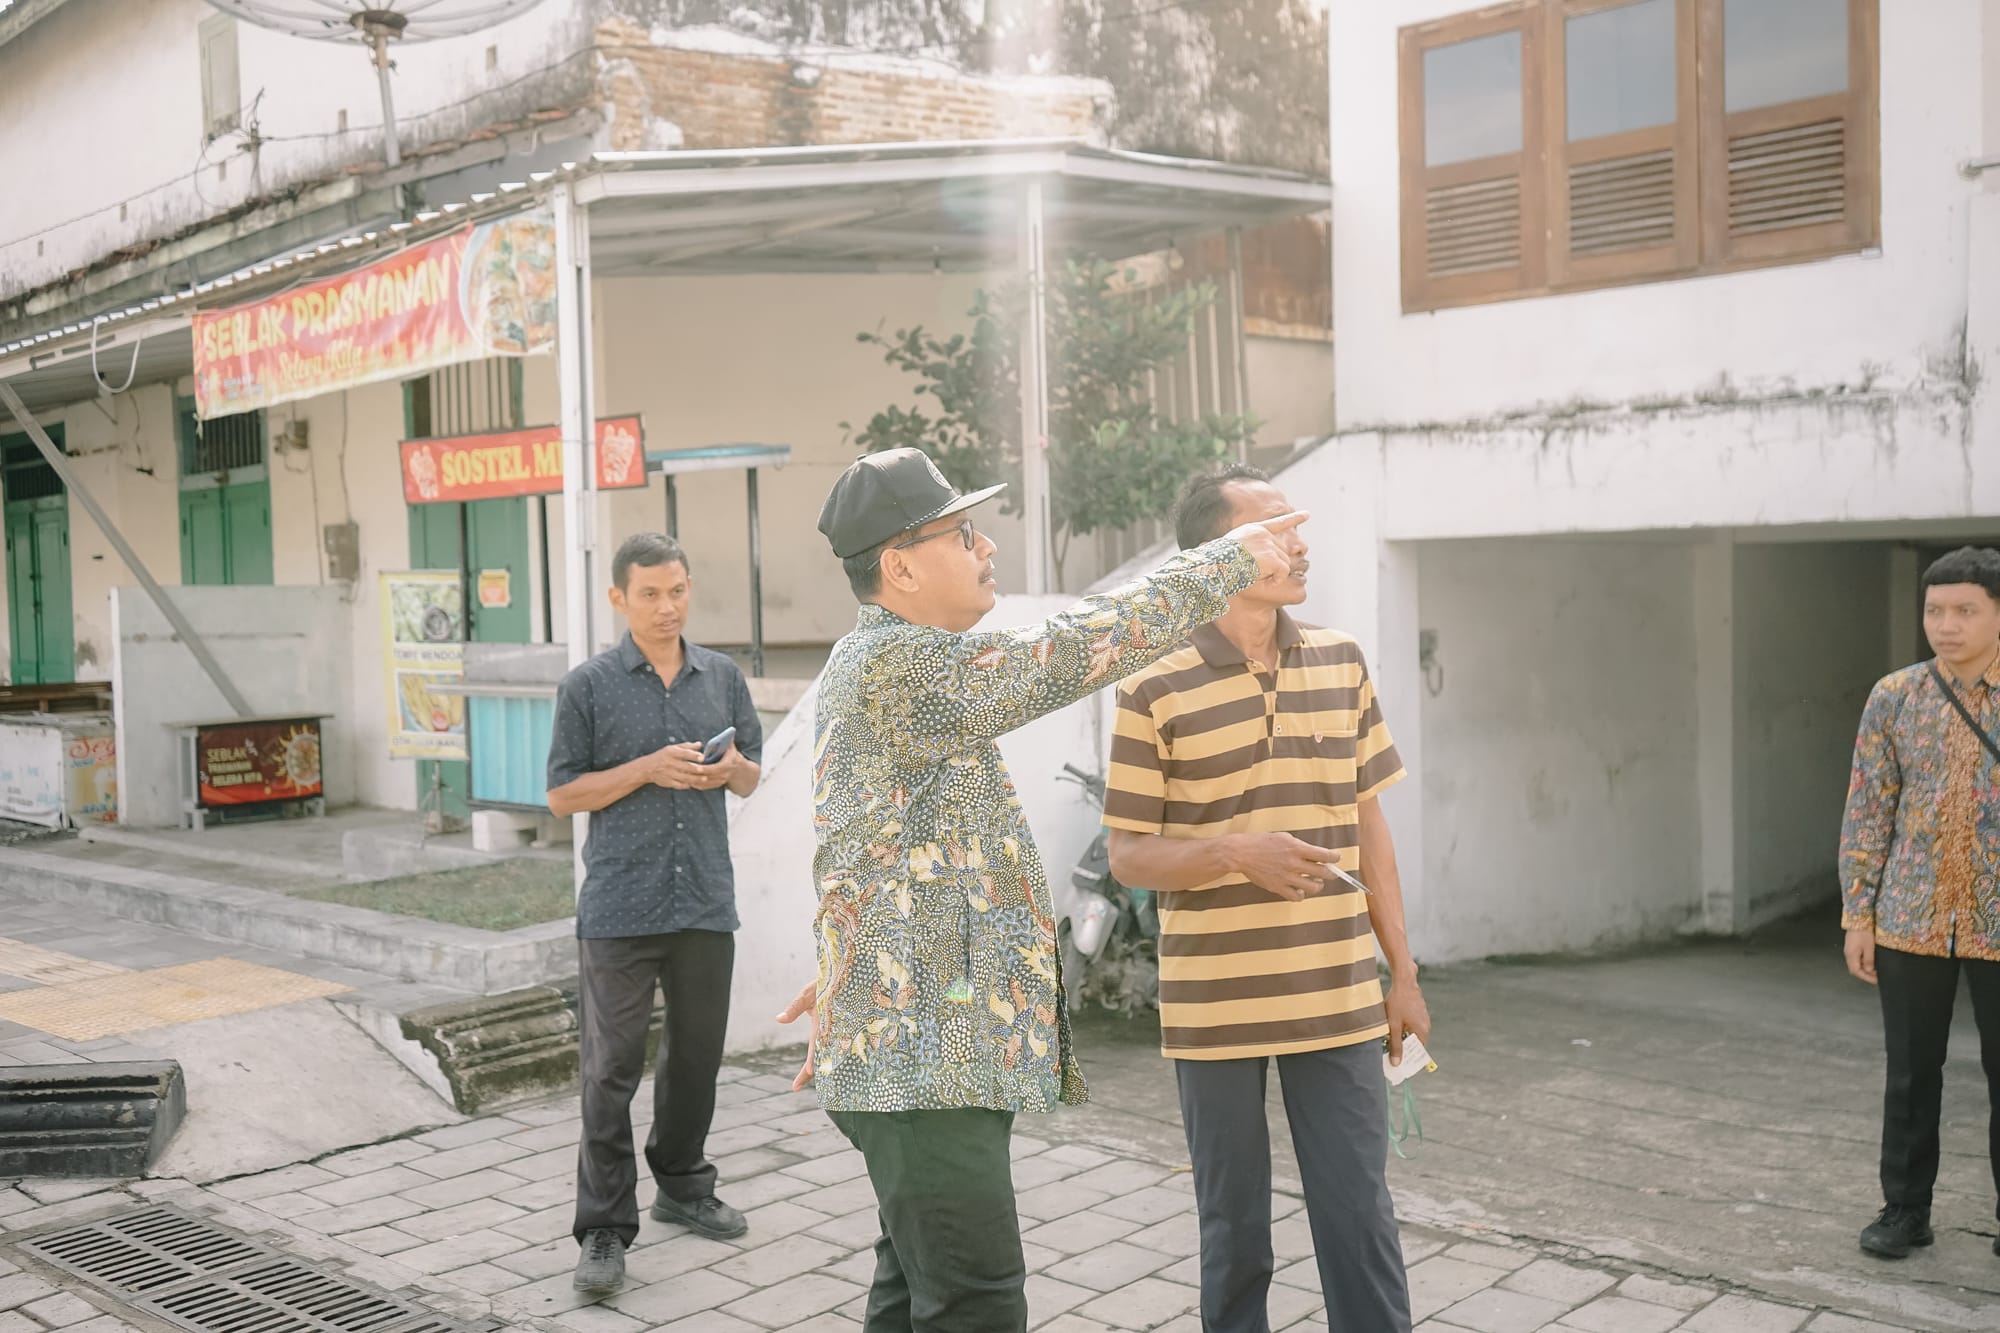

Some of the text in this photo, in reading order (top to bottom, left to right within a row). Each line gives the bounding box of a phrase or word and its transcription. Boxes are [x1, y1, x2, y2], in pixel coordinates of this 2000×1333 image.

[203, 252, 450, 362] SEBLAK PRASMANAN
[441, 445, 531, 487] SOSTEL
